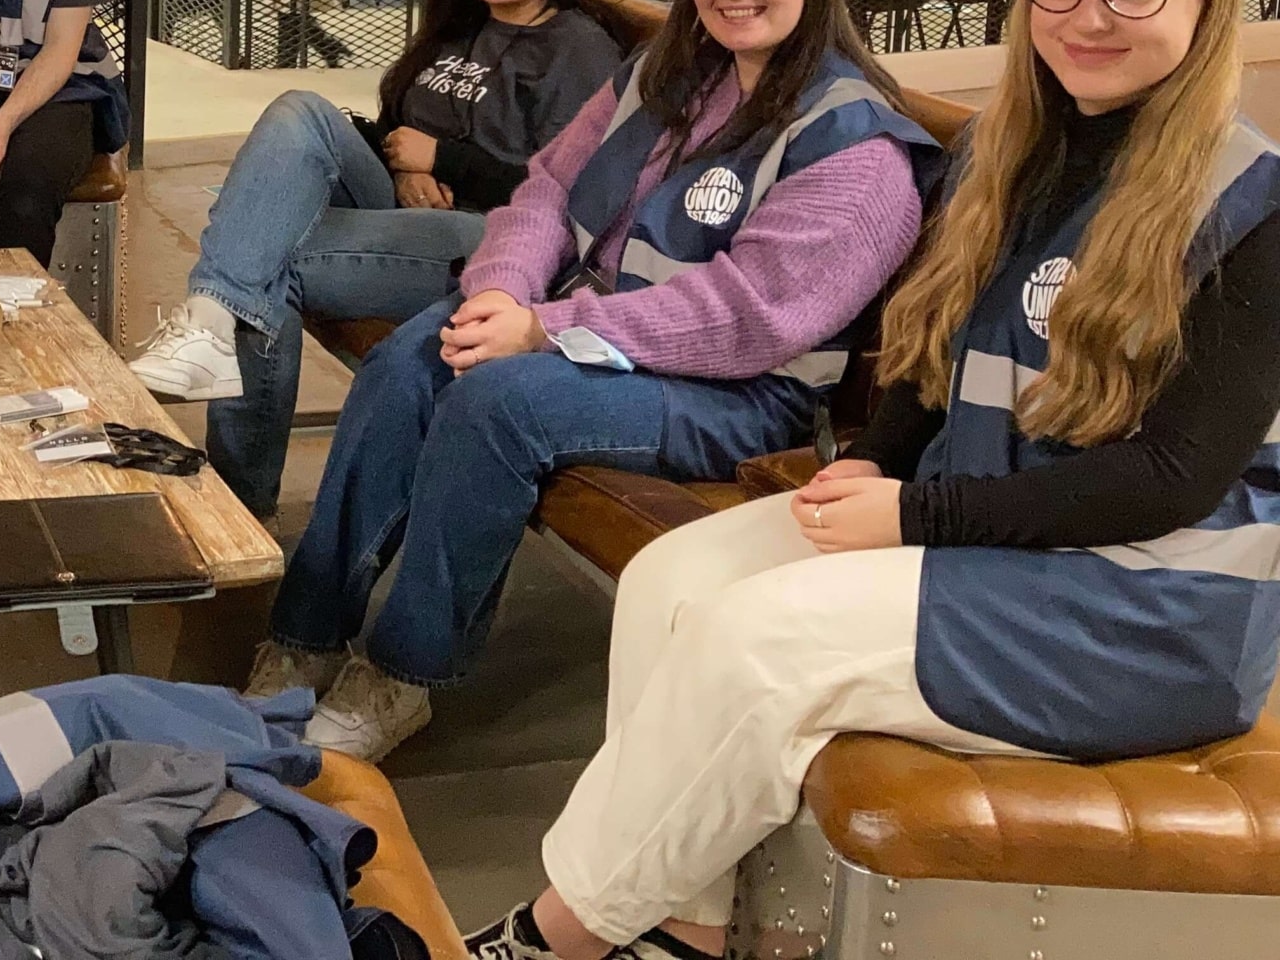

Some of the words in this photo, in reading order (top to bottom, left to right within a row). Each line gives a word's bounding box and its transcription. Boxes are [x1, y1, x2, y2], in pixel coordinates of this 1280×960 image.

[435, 55, 491, 77] Hear
[428, 71, 488, 103] listen
[693, 166, 744, 195] STRATH
[684, 186, 743, 214] UNION
[1030, 256, 1076, 285] STRA
[1022, 281, 1063, 320] UNI
[1026, 318, 1050, 340] EST.1
